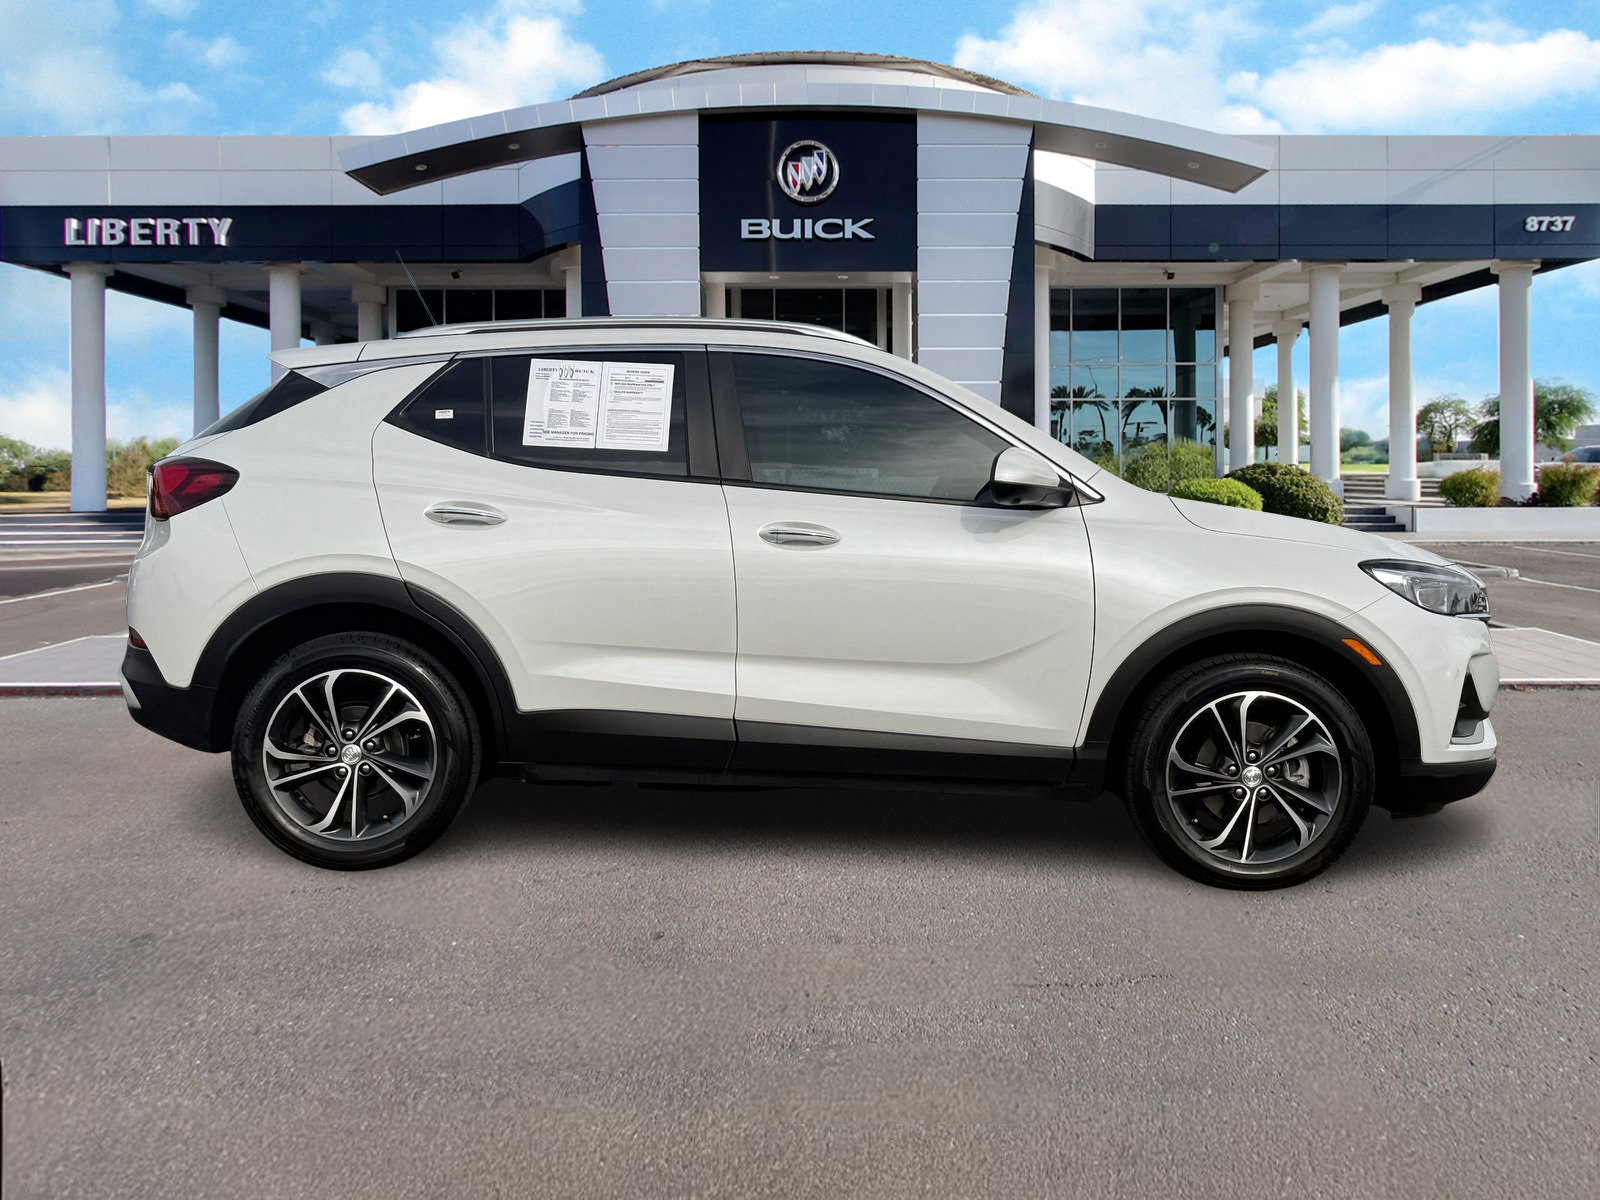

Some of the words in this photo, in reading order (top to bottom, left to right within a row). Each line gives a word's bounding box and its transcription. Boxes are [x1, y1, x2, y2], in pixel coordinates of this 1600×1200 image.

[64, 217, 233, 246] LIBERTY
[741, 218, 876, 239] BUICK
[1525, 215, 1576, 232] 8737
